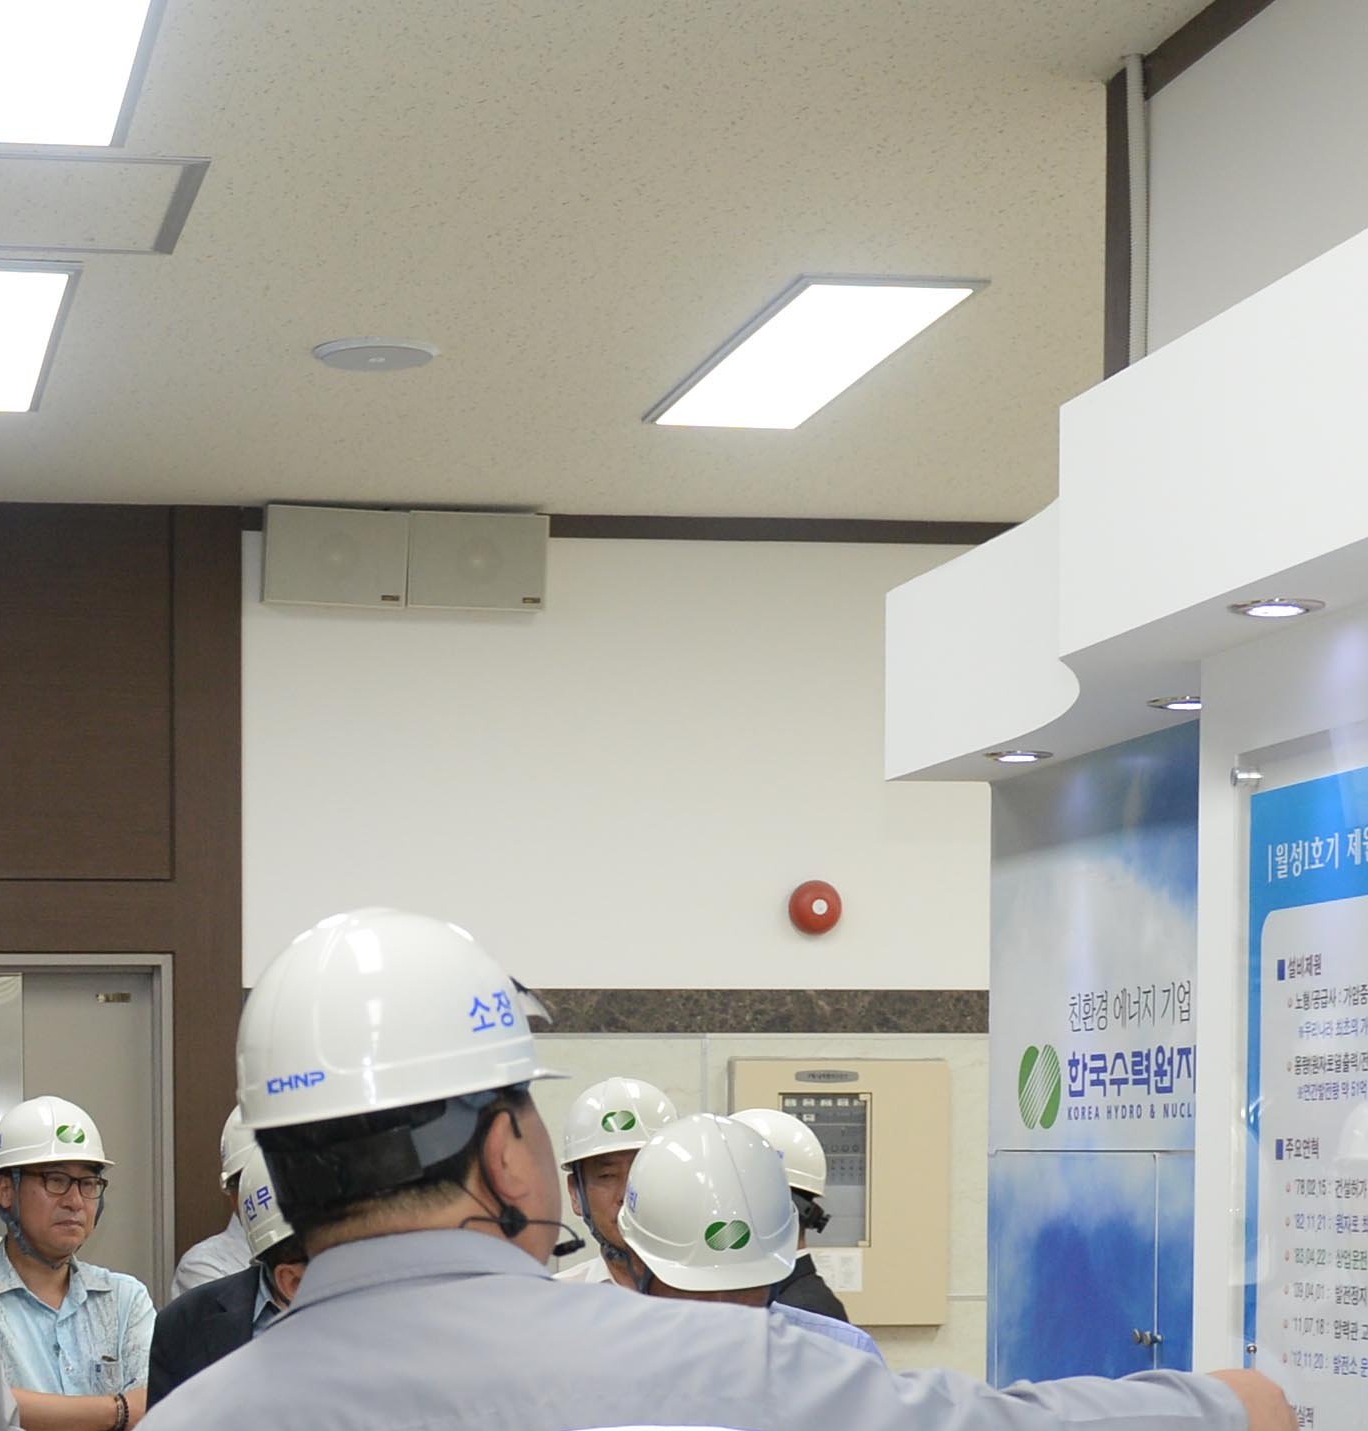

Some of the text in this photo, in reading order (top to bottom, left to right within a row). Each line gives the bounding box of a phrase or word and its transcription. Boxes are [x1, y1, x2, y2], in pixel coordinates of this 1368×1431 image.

[1274, 831, 1340, 880] 월성1호기
[468, 989, 516, 1033] 소장
[1068, 980, 1192, 1033] 친환경 에너지 기업
[266, 1070, 326, 1096] KHNP
[1067, 1102, 1193, 1121] KOREA HYDRO & NUCL
